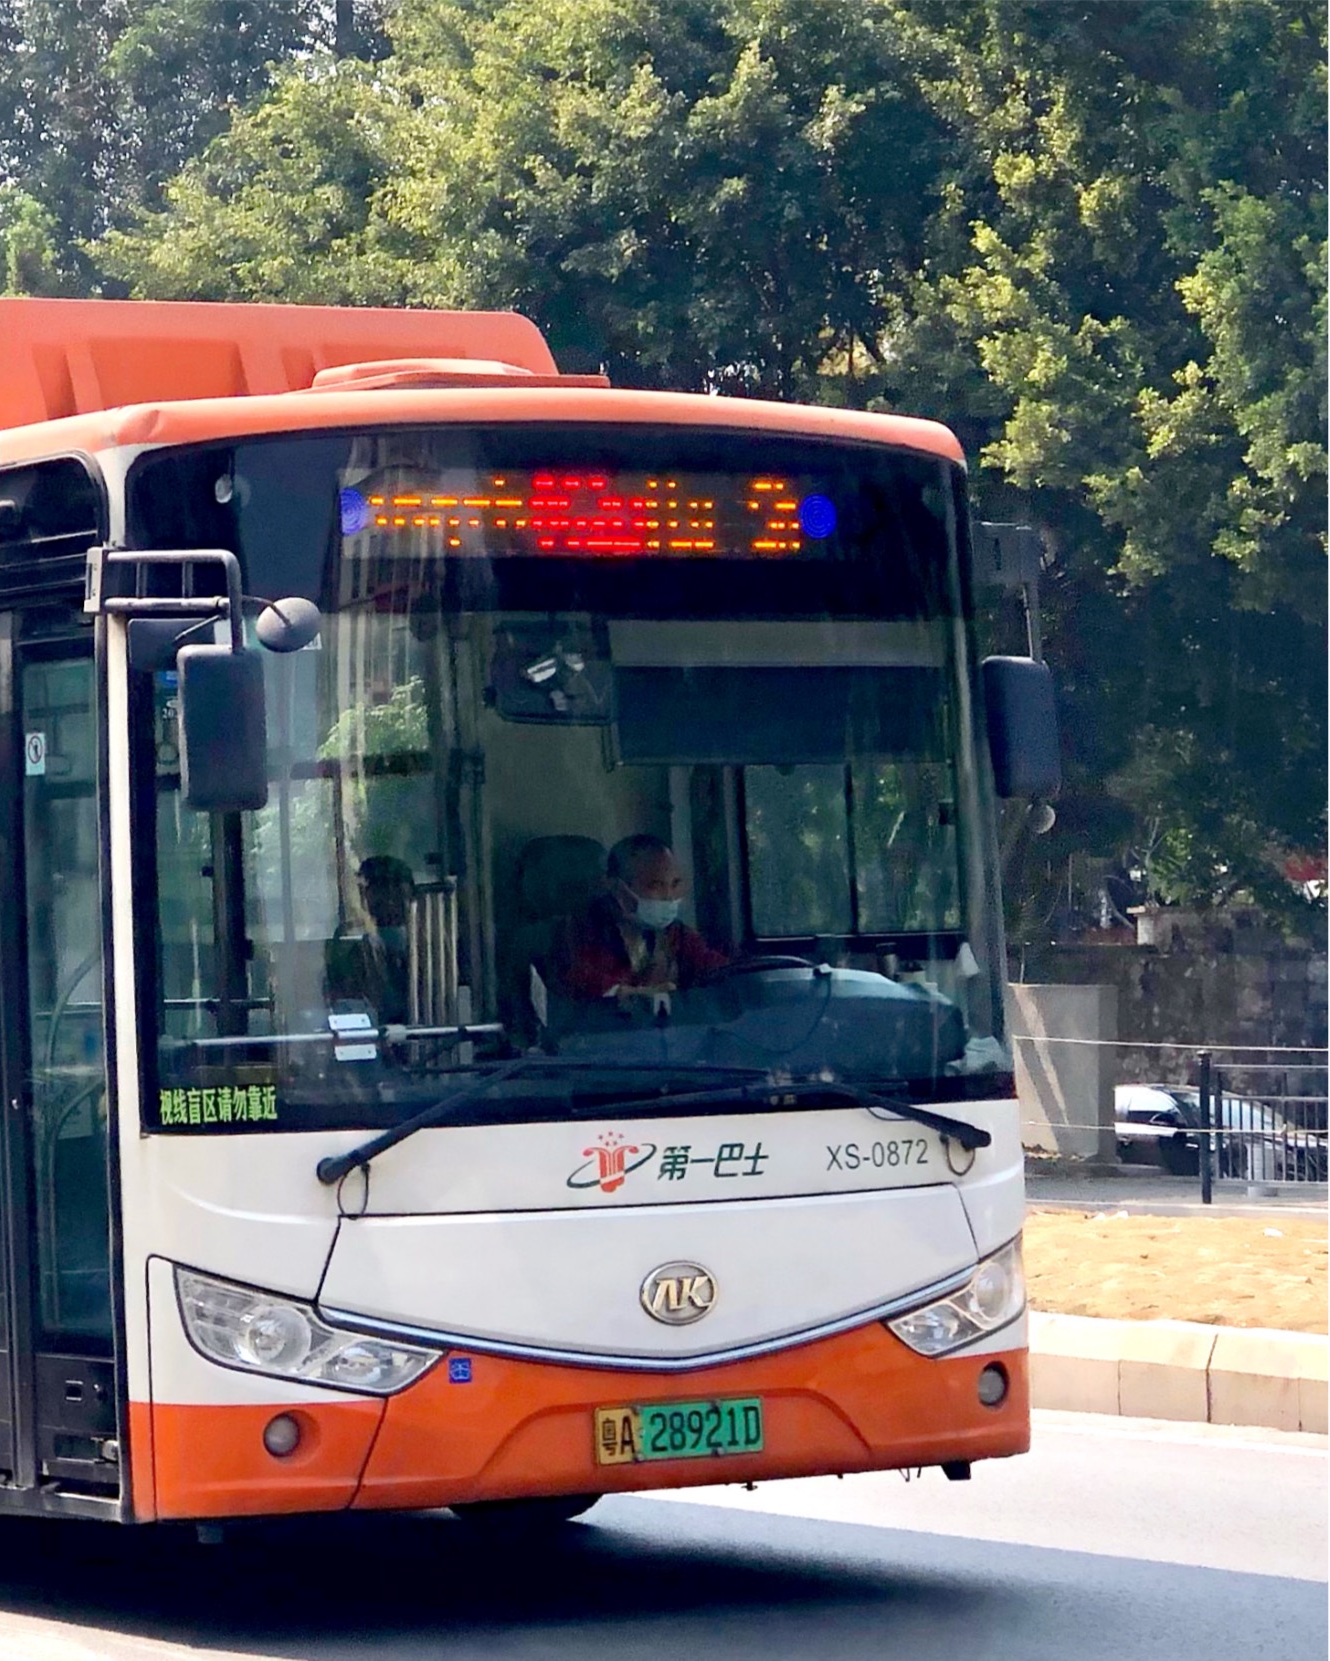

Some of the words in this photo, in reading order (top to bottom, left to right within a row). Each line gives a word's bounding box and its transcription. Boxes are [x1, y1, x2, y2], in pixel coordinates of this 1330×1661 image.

[159, 1085, 278, 1125] 视线盲区请勿靠近
[657, 1141, 770, 1182] 第一巴士
[826, 1138, 930, 1172] XS-0872
